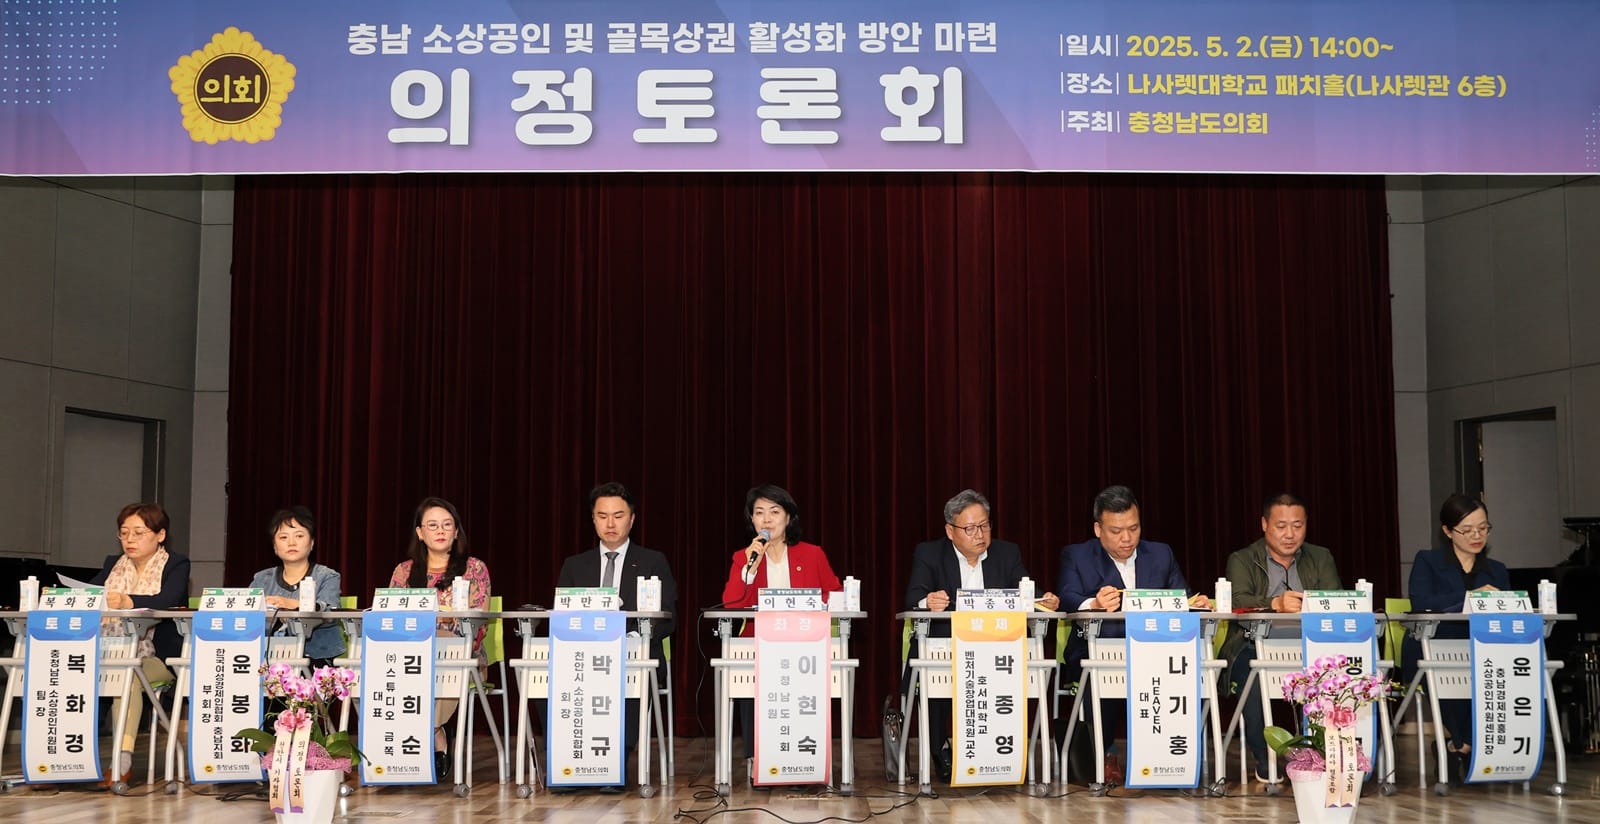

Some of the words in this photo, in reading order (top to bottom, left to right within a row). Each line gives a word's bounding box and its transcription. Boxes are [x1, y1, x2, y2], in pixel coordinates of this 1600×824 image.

[348, 24, 411, 54] 충남
[423, 24, 549, 54] 소상공인
[565, 24, 593, 53] 및
[607, 23, 734, 53] 골목상권
[749, 22, 846, 52] 활성화
[859, 23, 922, 52] 방안
[935, 23, 996, 52] 마련
[1067, 35, 1110, 56] 일시
[1128, 36, 1198, 56] 2025.
[1207, 36, 1228, 56] 5.
[1237, 36, 1302, 57] 2.(금)
[1311, 37, 1392, 57] 14:00~
[198, 68, 262, 106] 의회
[1067, 73, 1112, 93] 장소
[1128, 74, 1267, 95] 나사렛대학교
[1276, 75, 1449, 96] 패치홀(나사렛관
[1458, 76, 1506, 96] 6층)
[388, 67, 962, 145] 의정토론회
[1068, 111, 1112, 132] 주최
[1129, 112, 1268, 134] 충청남도의회
[46, 597, 96, 608] 복화경
[380, 597, 429, 608] 김희순
[561, 596, 612, 608] 박만규
[964, 598, 1014, 609] 박종영
[1132, 598, 1182, 609] 나기홍
[1477, 600, 1527, 610] 윤은기
[46, 617, 81, 629] 토론
[211, 618, 246, 630] 토론
[381, 618, 416, 630] 토론
[569, 618, 606, 630] 토론
[971, 618, 1007, 630] 발제
[1145, 619, 1181, 631] 토론
[1321, 619, 1356, 632] 토론
[1489, 621, 1524, 633] 토론
[50, 650, 59, 686] 충청남도
[574, 652, 584, 682] 천안시
[36, 691, 46, 717] 팀장
[65, 655, 85, 753] 복화경
[202, 685, 212, 723] 부회장
[231, 654, 250, 754] 윤봉화
[373, 692, 383, 717] 대표
[385, 668, 395, 720] 스튜디오
[402, 656, 421, 754] 김희순
[561, 692, 571, 719] 회장
[591, 656, 612, 756] 박만규
[797, 655, 817, 755] 이현숙
[978, 676, 987, 734] 호서대학교
[995, 656, 1014, 754] 박종영
[1140, 693, 1149, 718] 대표
[1152, 677, 1161, 733] HEAVEN
[1169, 656, 1187, 755] 나기홍
[1513, 658, 1531, 755] 윤은기
[384, 732, 394, 756] 금쪽
[966, 741, 975, 759] 교수
